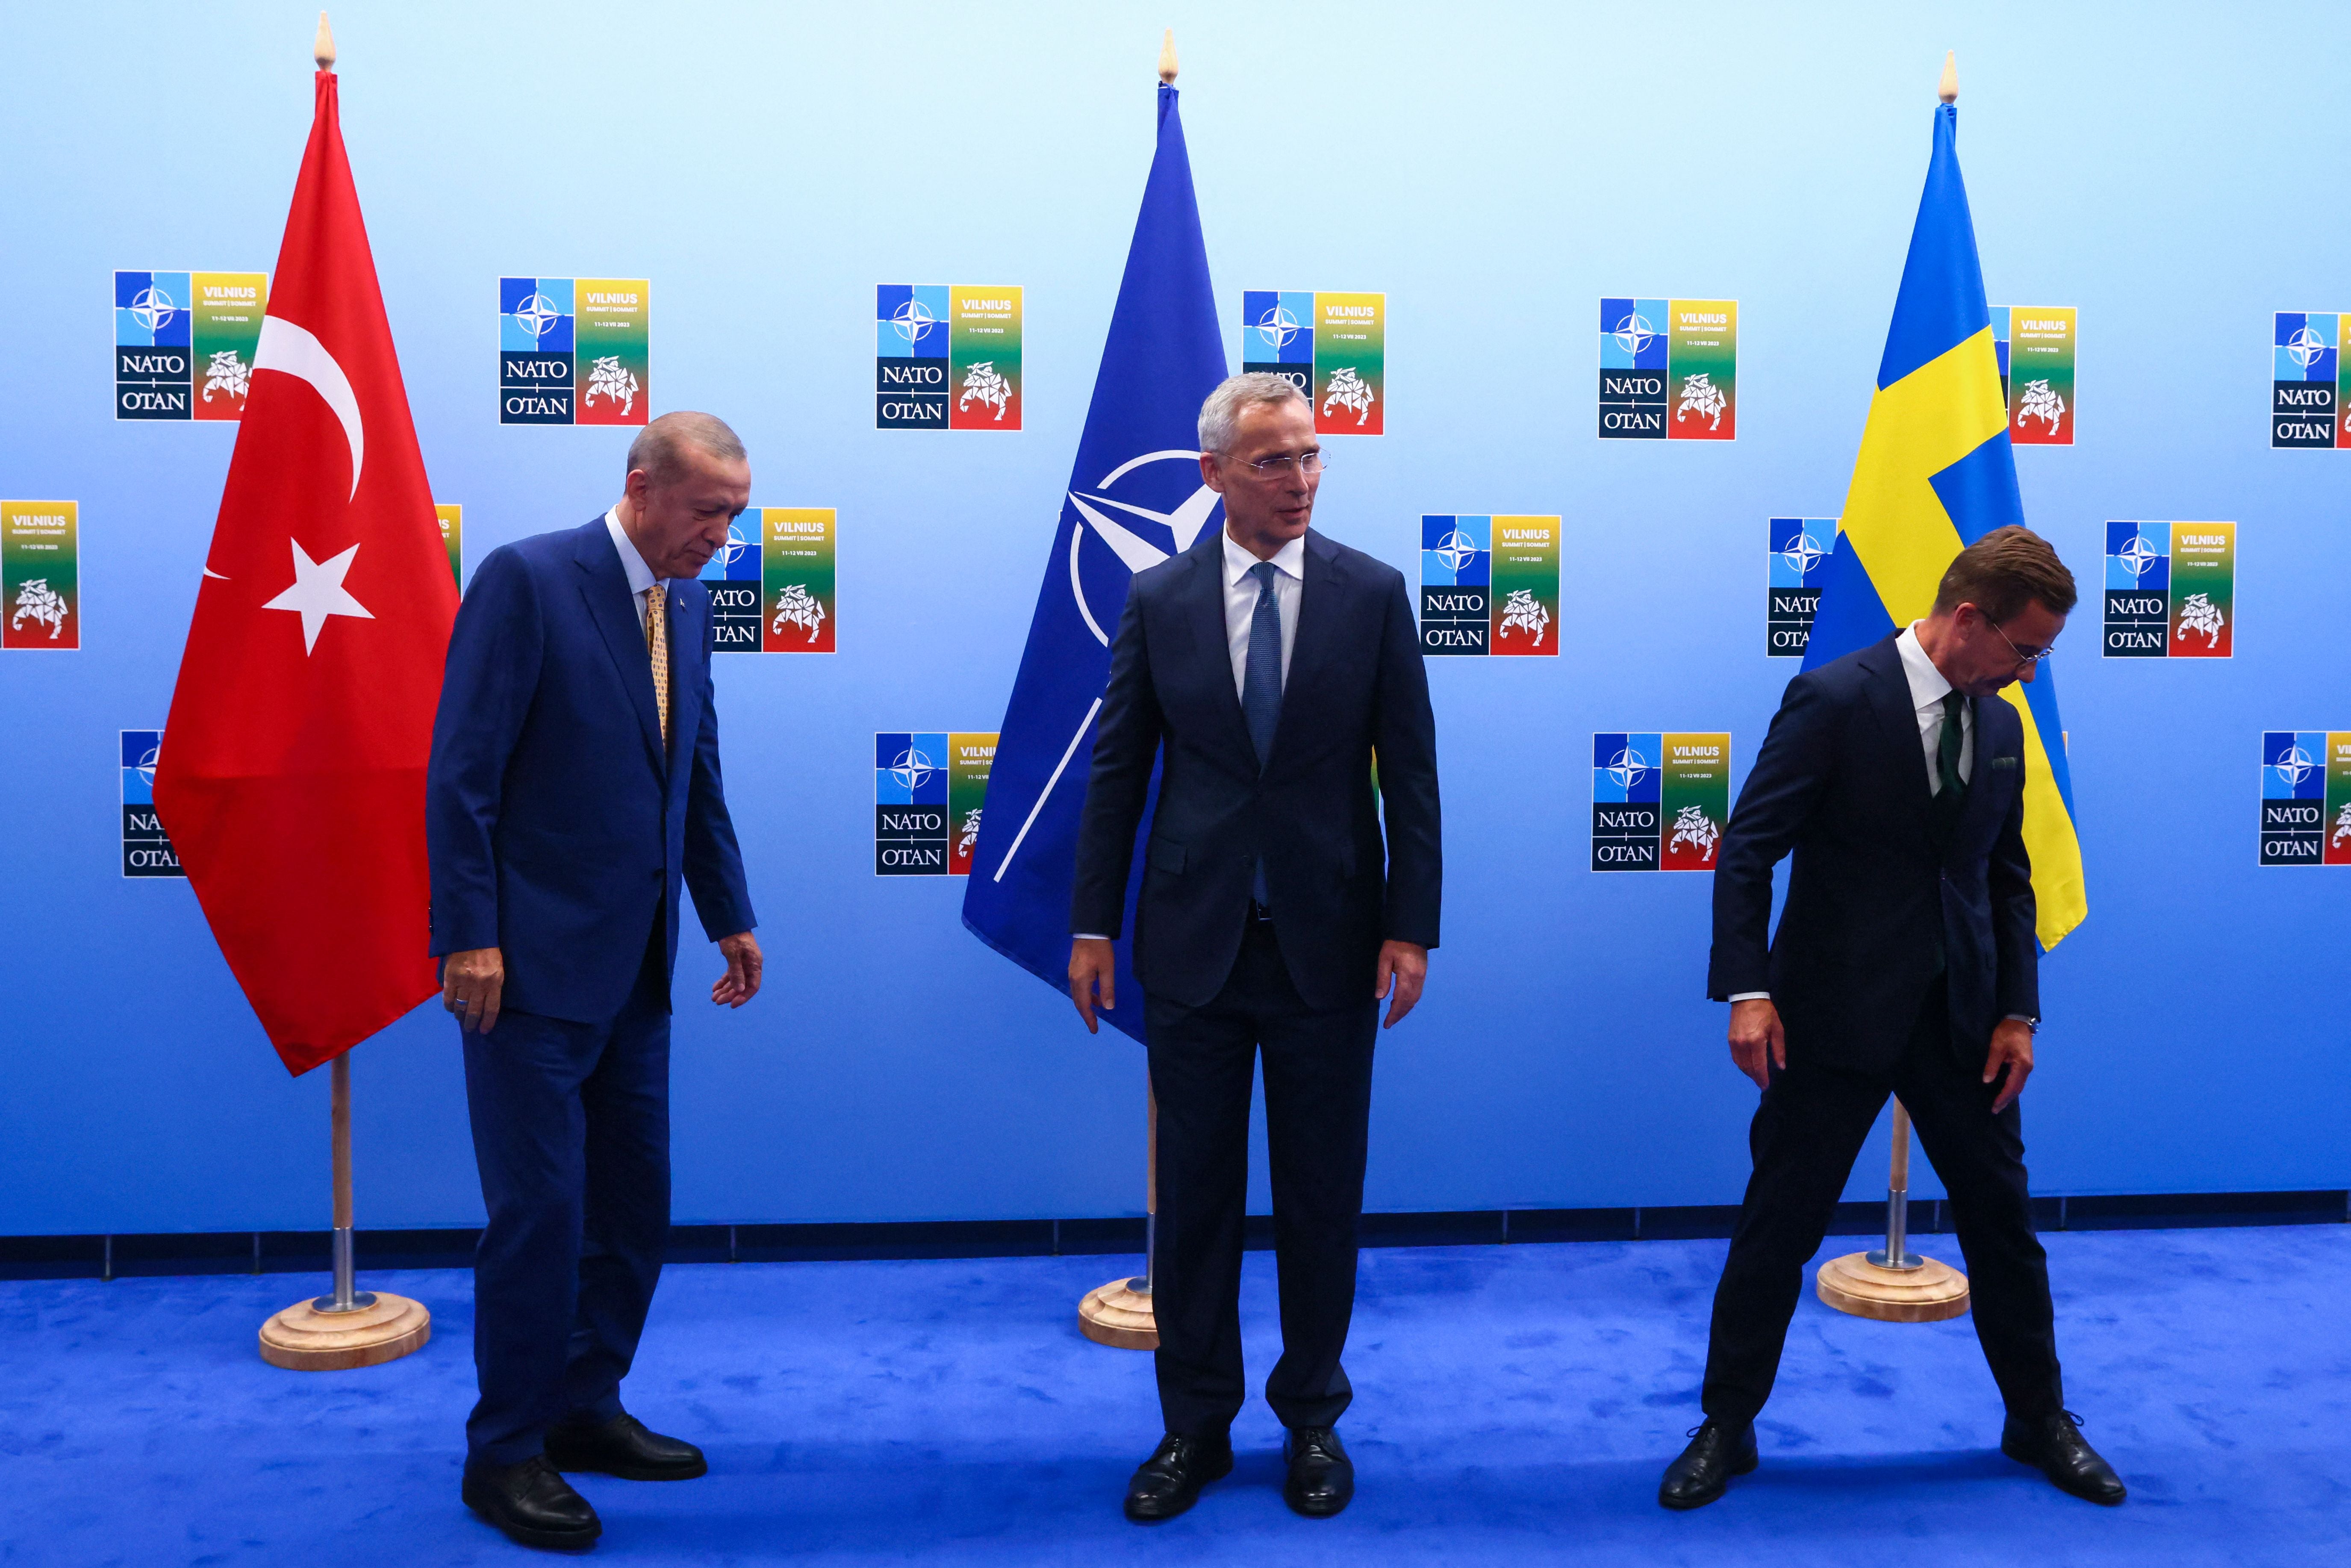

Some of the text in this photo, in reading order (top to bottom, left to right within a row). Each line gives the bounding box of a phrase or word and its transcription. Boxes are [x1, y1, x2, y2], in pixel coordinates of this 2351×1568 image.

[203, 287, 256, 298] VILNIUS
[587, 293, 637, 304] VILNIUS
[962, 300, 1011, 310] VILNIUS
[1326, 306, 1374, 317] VILNIUS
[1680, 313, 1727, 324] VILNIUS
[2021, 320, 2066, 330] VILNIUS
[122, 356, 184, 373] NATO
[507, 361, 567, 378] NATO
[883, 367, 942, 383] NATO
[1605, 378, 1661, 394] NATO
[122, 392, 185, 410] OTAN
[2278, 389, 2330, 405] NATO
[507, 398, 567, 414] OTAN
[883, 403, 943, 419] OTAN
[1605, 413, 1661, 429] OTAN
[2277, 423, 2330, 439] OTAN
[12, 516, 66, 526] VILNIUS
[775, 522, 824, 533] VILNIUS
[1503, 529, 1550, 539] VILNIUS
[2181, 535, 2225, 545] VILNIUS
[1427, 595, 1483, 610] NATO
[2110, 598, 2162, 614] NATO
[713, 626, 756, 643] TAN
[1426, 630, 1483, 645] OTAN
[1773, 631, 1809, 647] OTA
[2109, 632, 2162, 647] OTAN
[960, 746, 996, 757] VILNI
[1673, 746, 1719, 756] VILNIUS
[129, 813, 165, 831] NA
[883, 814, 940, 829] NATO
[1599, 812, 1653, 827] NATO
[2267, 808, 2319, 822] NATO
[1598, 846, 1653, 861] OTAN
[2266, 841, 2318, 856] OTAN
[882, 849, 941, 865] OTAN
